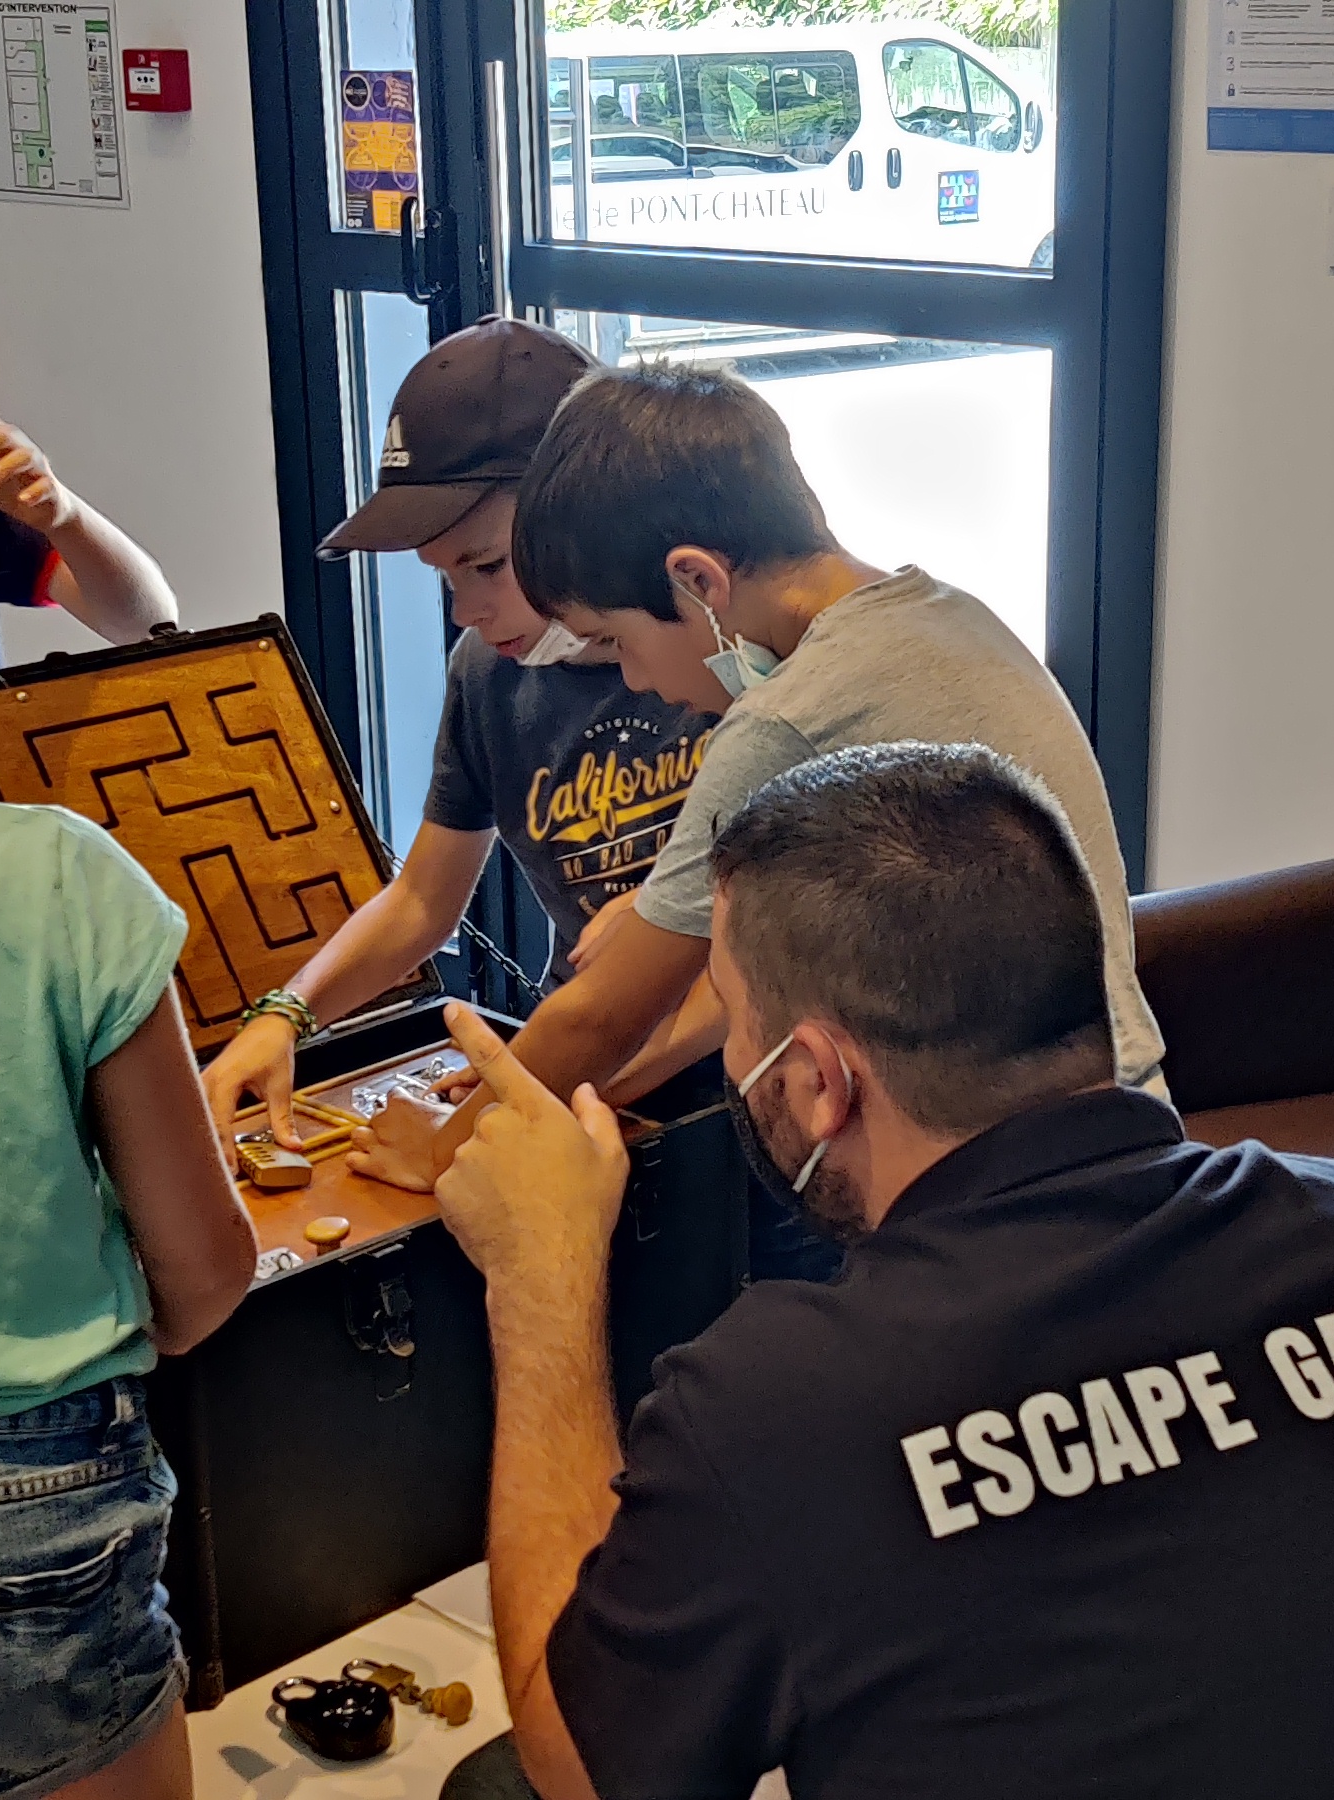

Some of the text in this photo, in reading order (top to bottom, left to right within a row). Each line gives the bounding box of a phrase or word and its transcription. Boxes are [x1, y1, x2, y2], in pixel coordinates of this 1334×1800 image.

[631, 188, 825, 225] PONT-CHATEAU
[584, 717, 659, 739] ORIGINAL
[899, 1351, 1259, 1539] ESCAPE
